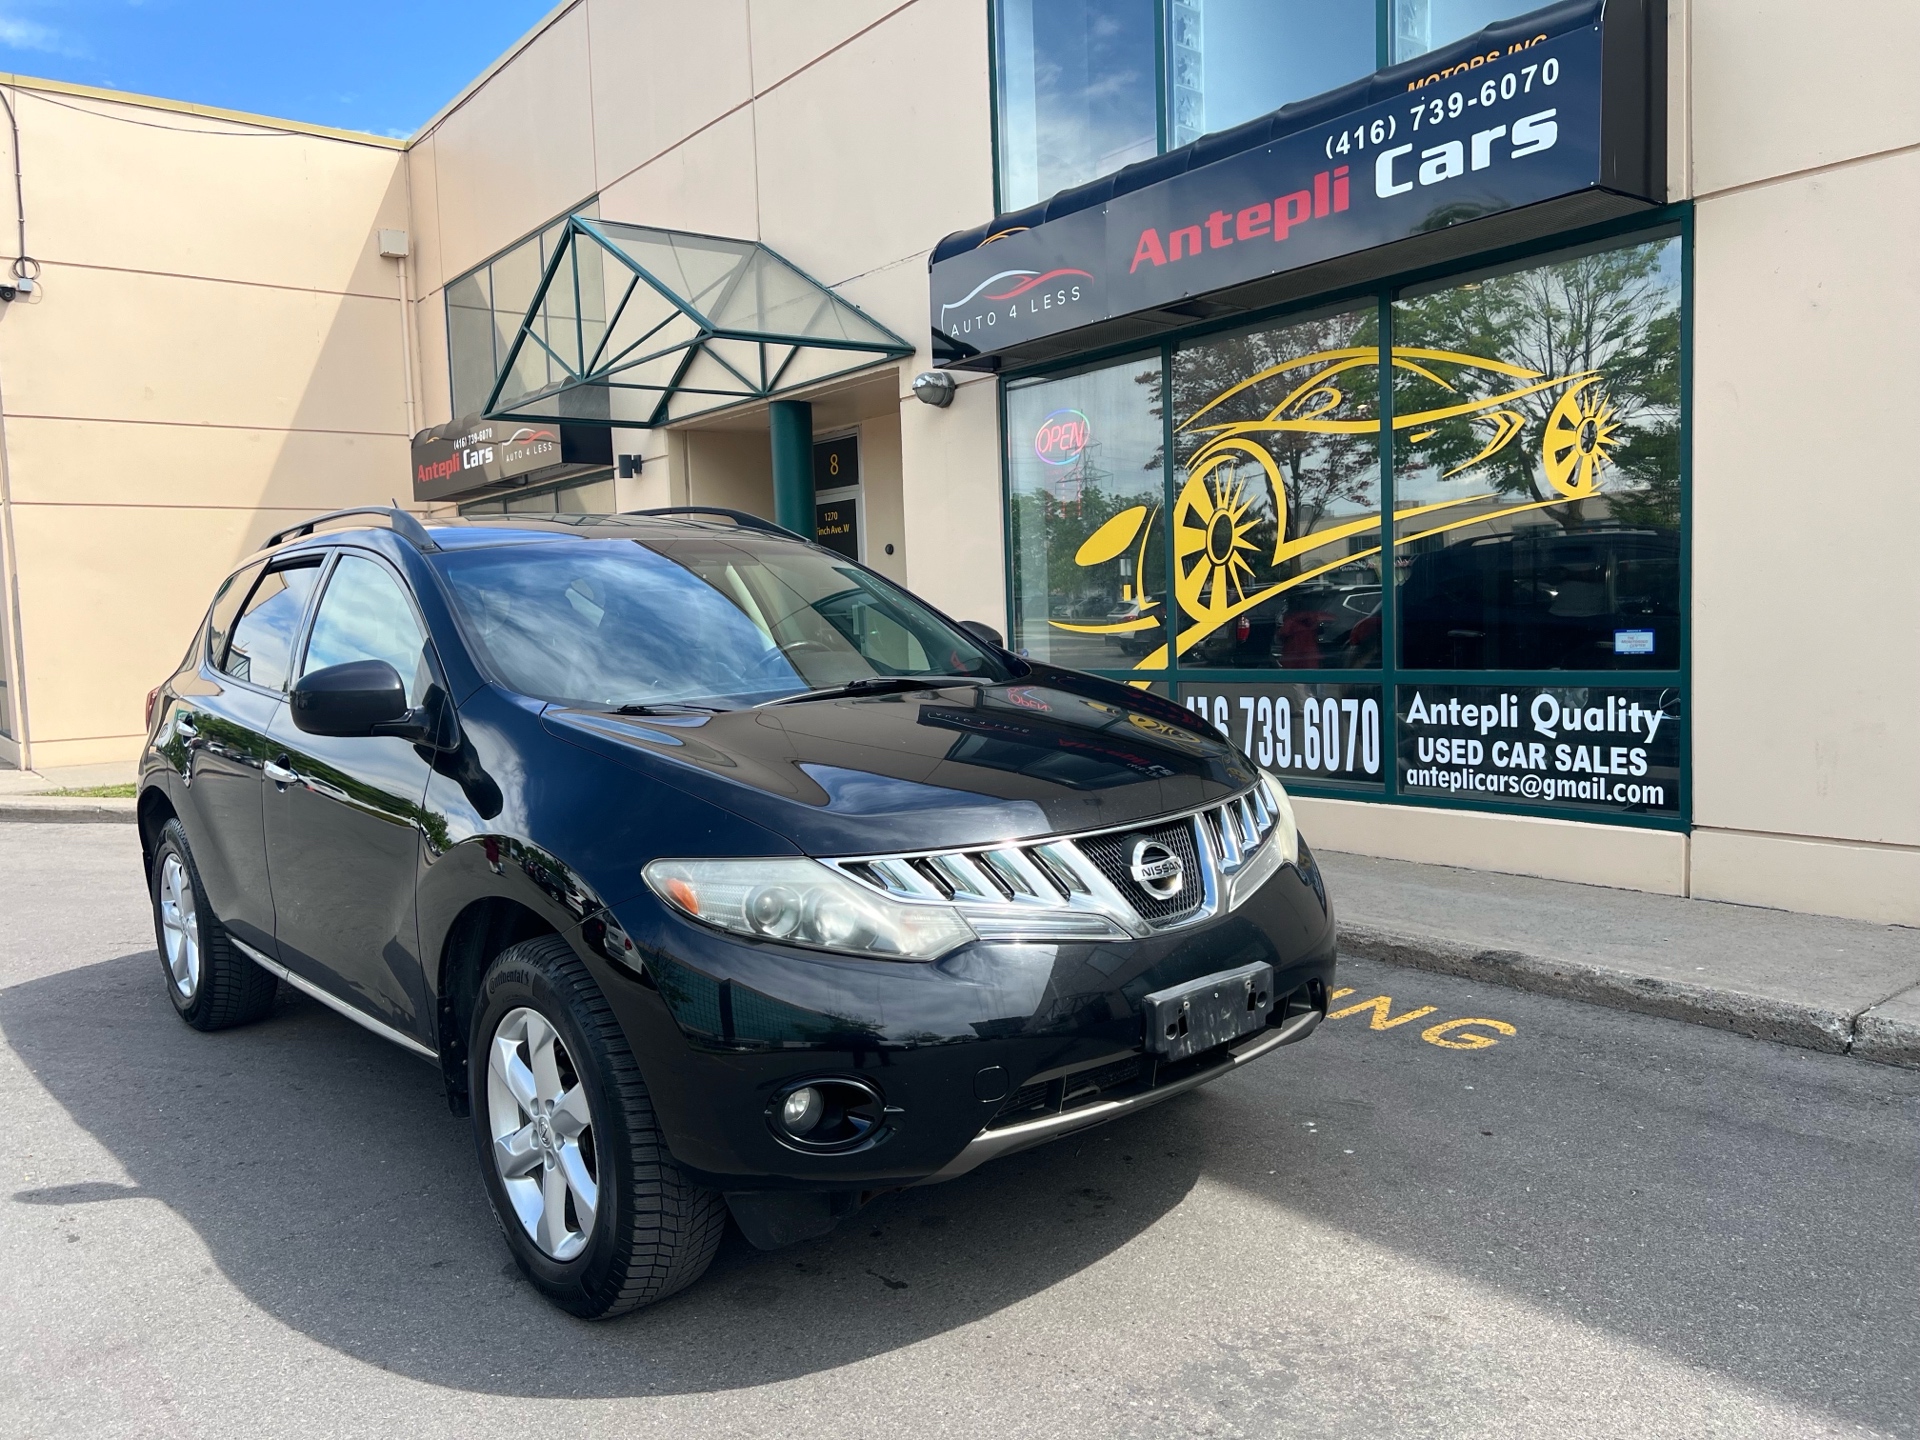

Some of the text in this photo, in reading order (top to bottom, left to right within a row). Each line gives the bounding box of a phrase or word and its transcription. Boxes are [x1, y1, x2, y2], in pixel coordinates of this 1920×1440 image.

[1325, 57, 1560, 159] (416) 739-6070
[1129, 108, 1558, 274] Antepli Cars
[950, 286, 1081, 338] AUTO 4 LESS
[453, 427, 493, 451] (416) 739-6070
[506, 441, 553, 463] AUTO 4 LESS
[1037, 420, 1085, 453] OPEN
[417, 446, 494, 484] Antepli Cars
[830, 453, 839, 475] 8
[824, 511, 838, 522] 1270
[843, 523, 850, 533] W
[1405, 690, 1664, 744] Antepli Quality
[1417, 736, 1648, 777] USED CAR SALES
[1405, 766, 1665, 805] anteplicars@gmail.com
[1141, 861, 1182, 877] NISSAN
